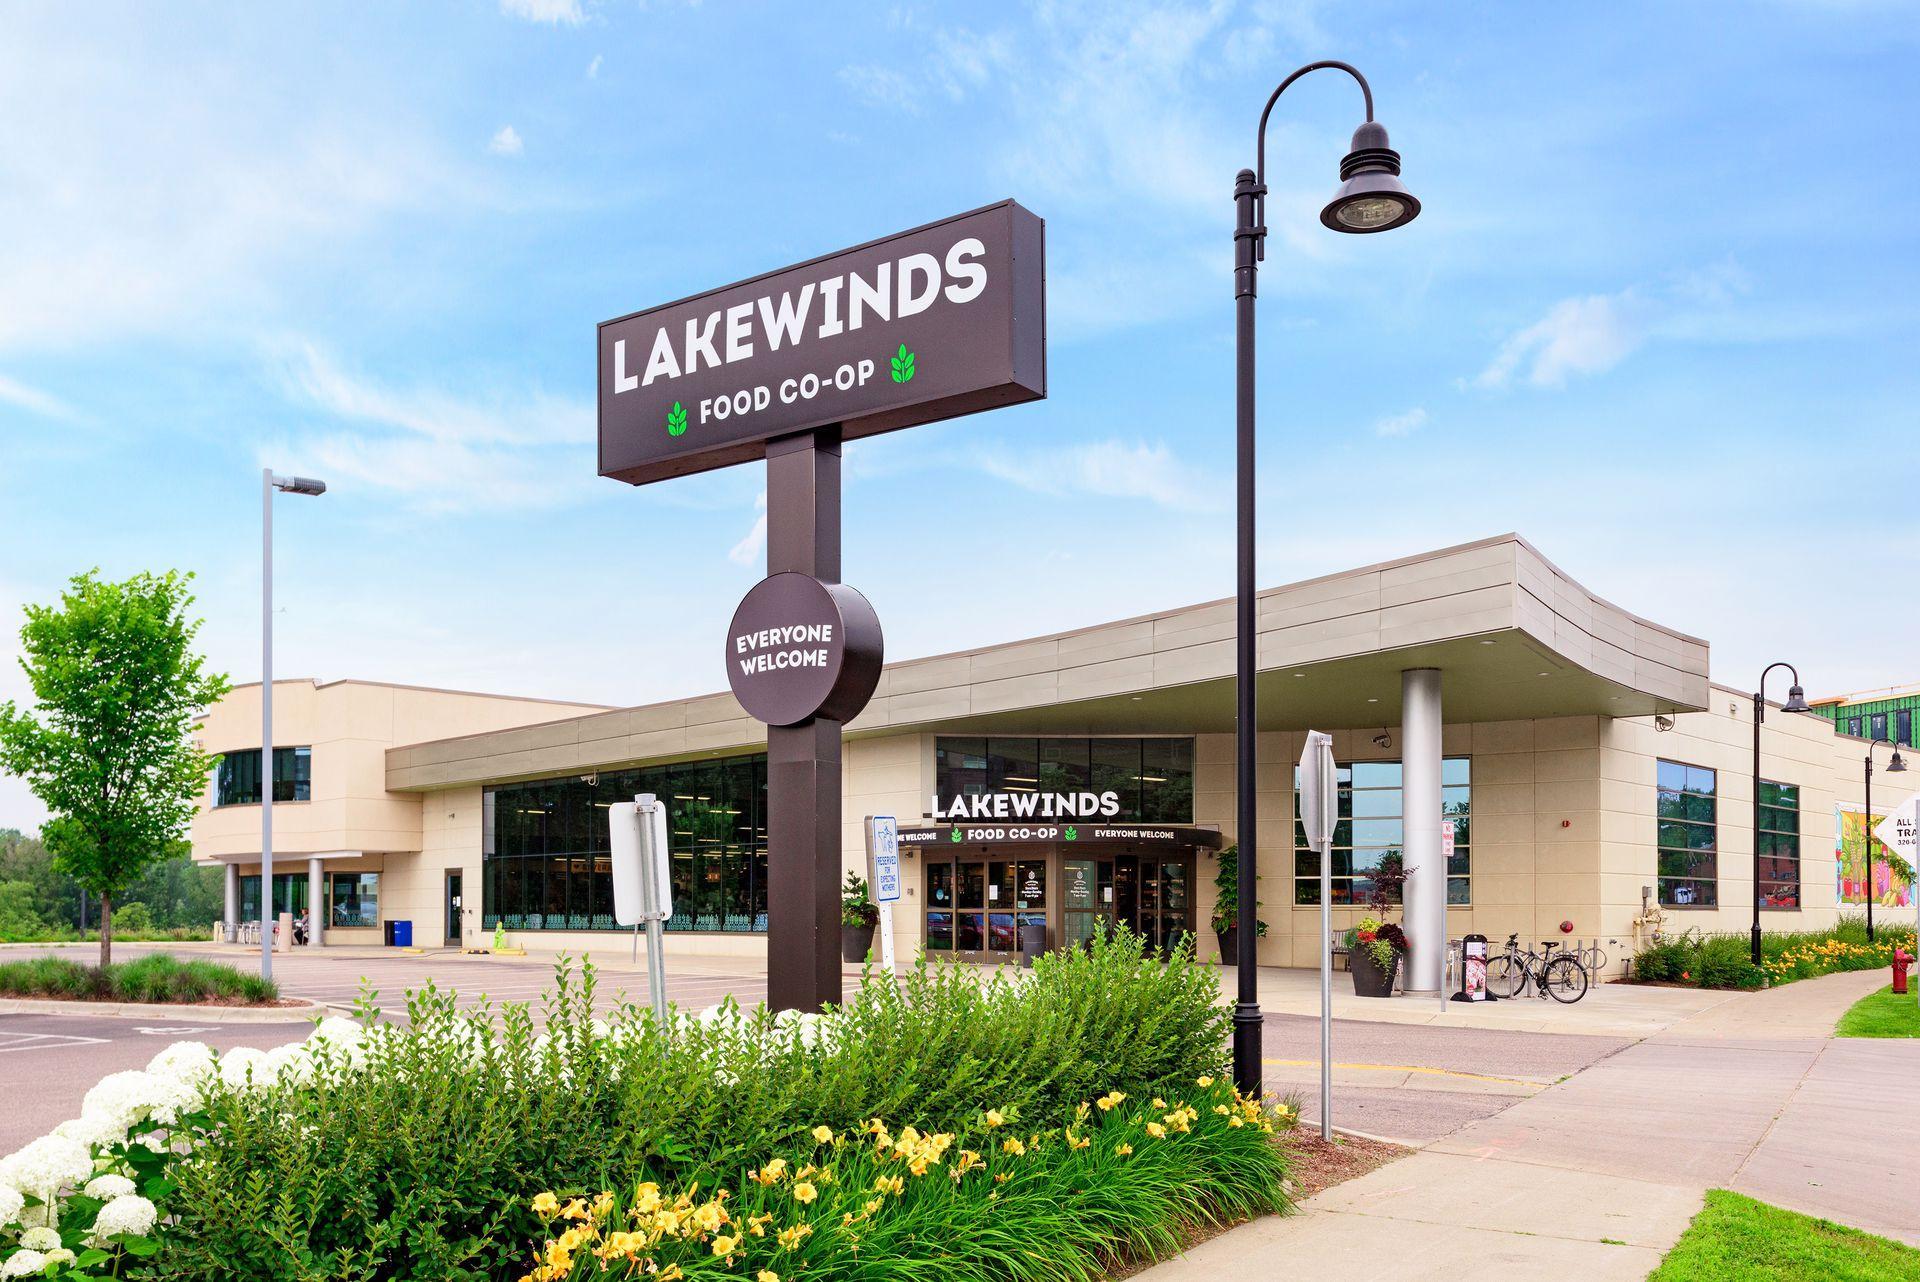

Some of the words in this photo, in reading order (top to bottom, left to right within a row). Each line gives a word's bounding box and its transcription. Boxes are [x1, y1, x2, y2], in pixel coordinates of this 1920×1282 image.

[614, 238, 988, 394] LAKEWINDS
[700, 386, 771, 424] FOOD
[779, 359, 874, 405] CO-OP
[736, 624, 833, 654] EVERYONE
[740, 649, 828, 676] WELCOME
[931, 791, 1120, 818] LAKEWINDS
[1896, 818, 1911, 826] ALL
[905, 832, 937, 841] WELCOME
[967, 829, 1005, 840] FOOD
[1009, 827, 1058, 839] CO-OP
[1094, 829, 1138, 838] EVERYONE
[1140, 830, 1175, 839] WELCOME
[1896, 828, 1917, 837] TRA
